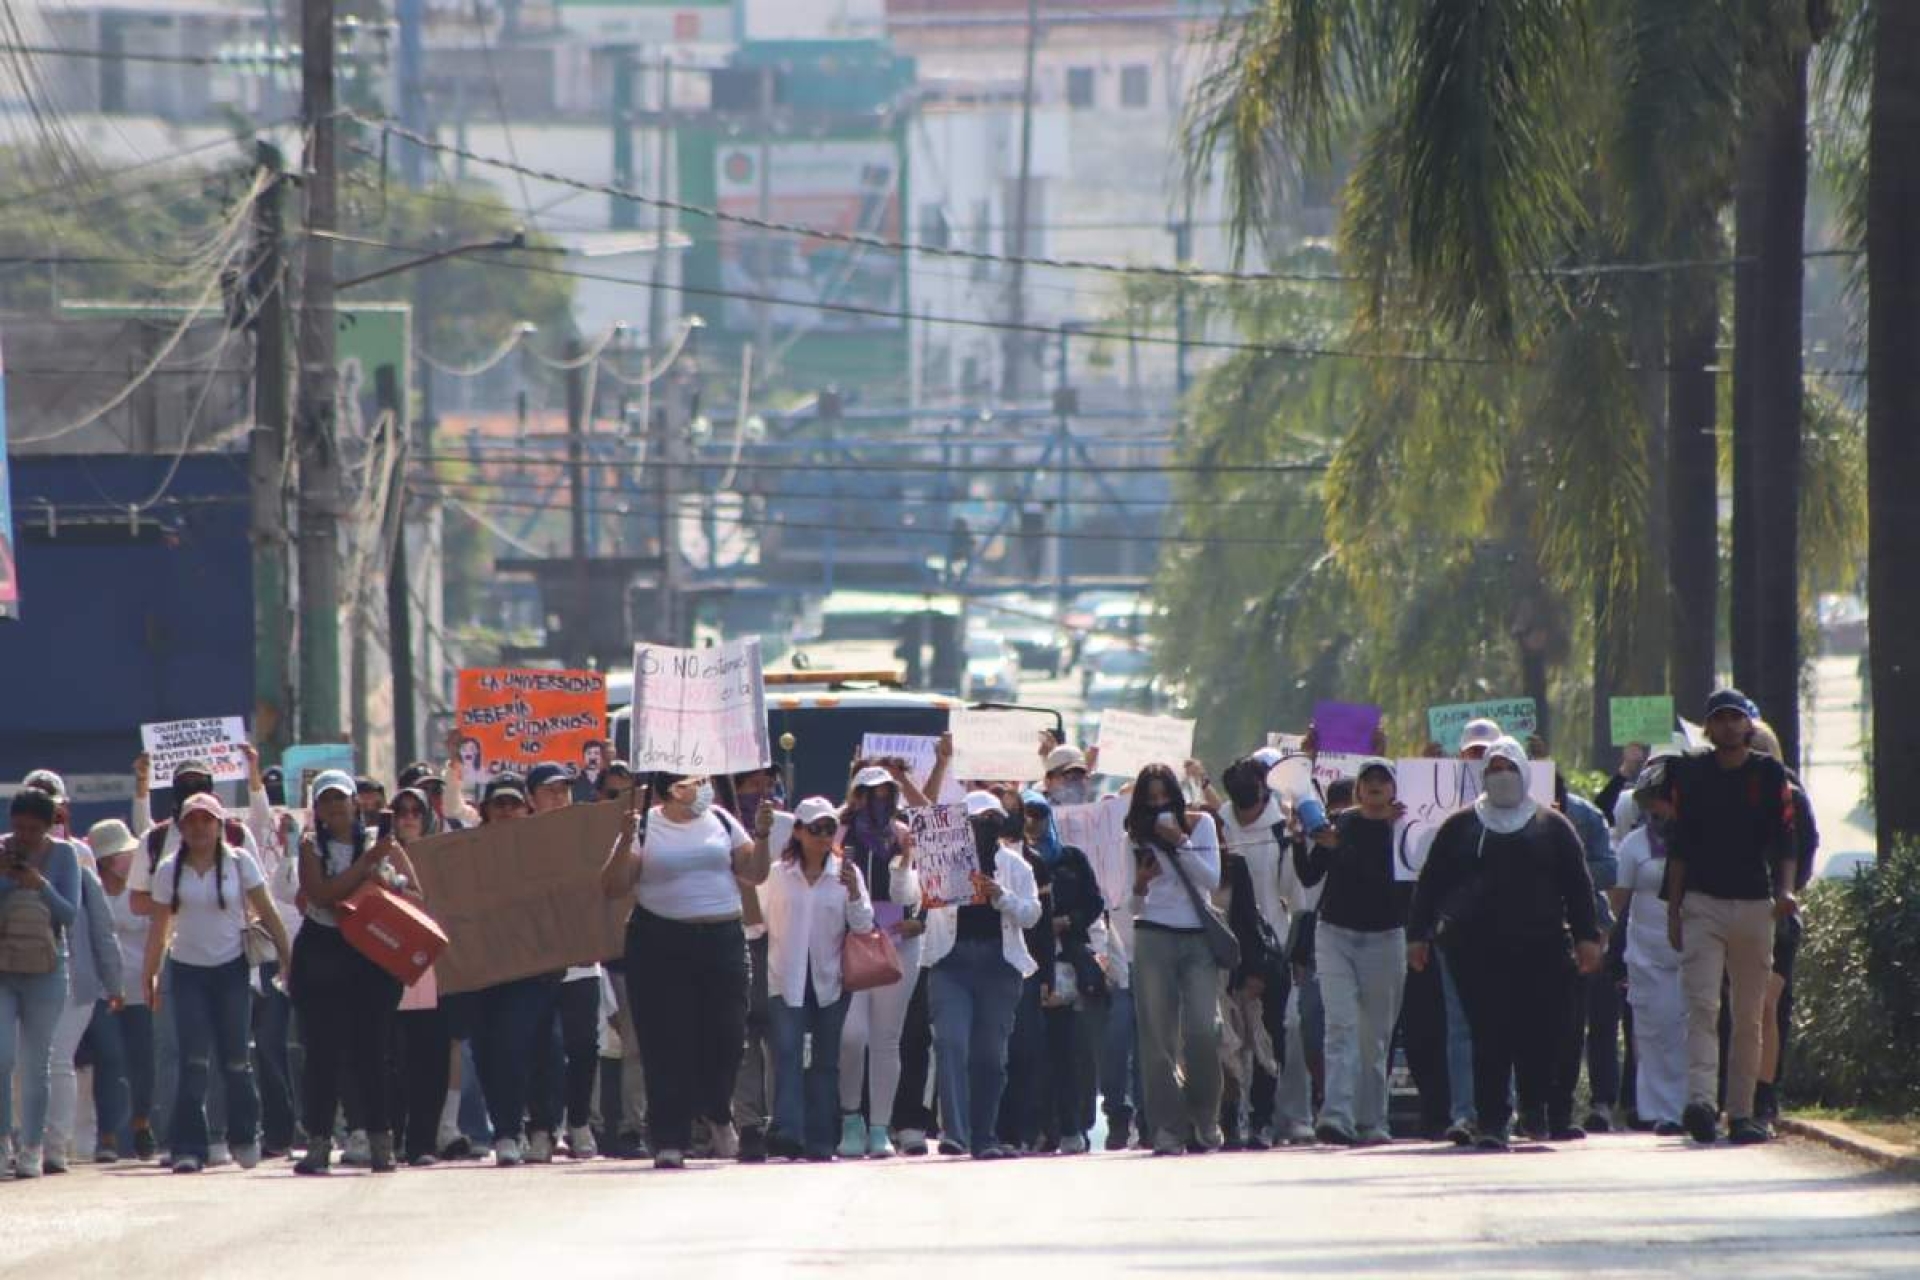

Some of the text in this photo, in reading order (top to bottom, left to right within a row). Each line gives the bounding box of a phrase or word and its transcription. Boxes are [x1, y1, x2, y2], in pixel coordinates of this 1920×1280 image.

[674, 655, 699, 678] NO
[480, 673, 602, 691] LA UNIVERSIDAD
[153, 719, 222, 733] QUIERO VER
[211, 744, 227, 754] NO
[520, 740, 541, 752] NO
